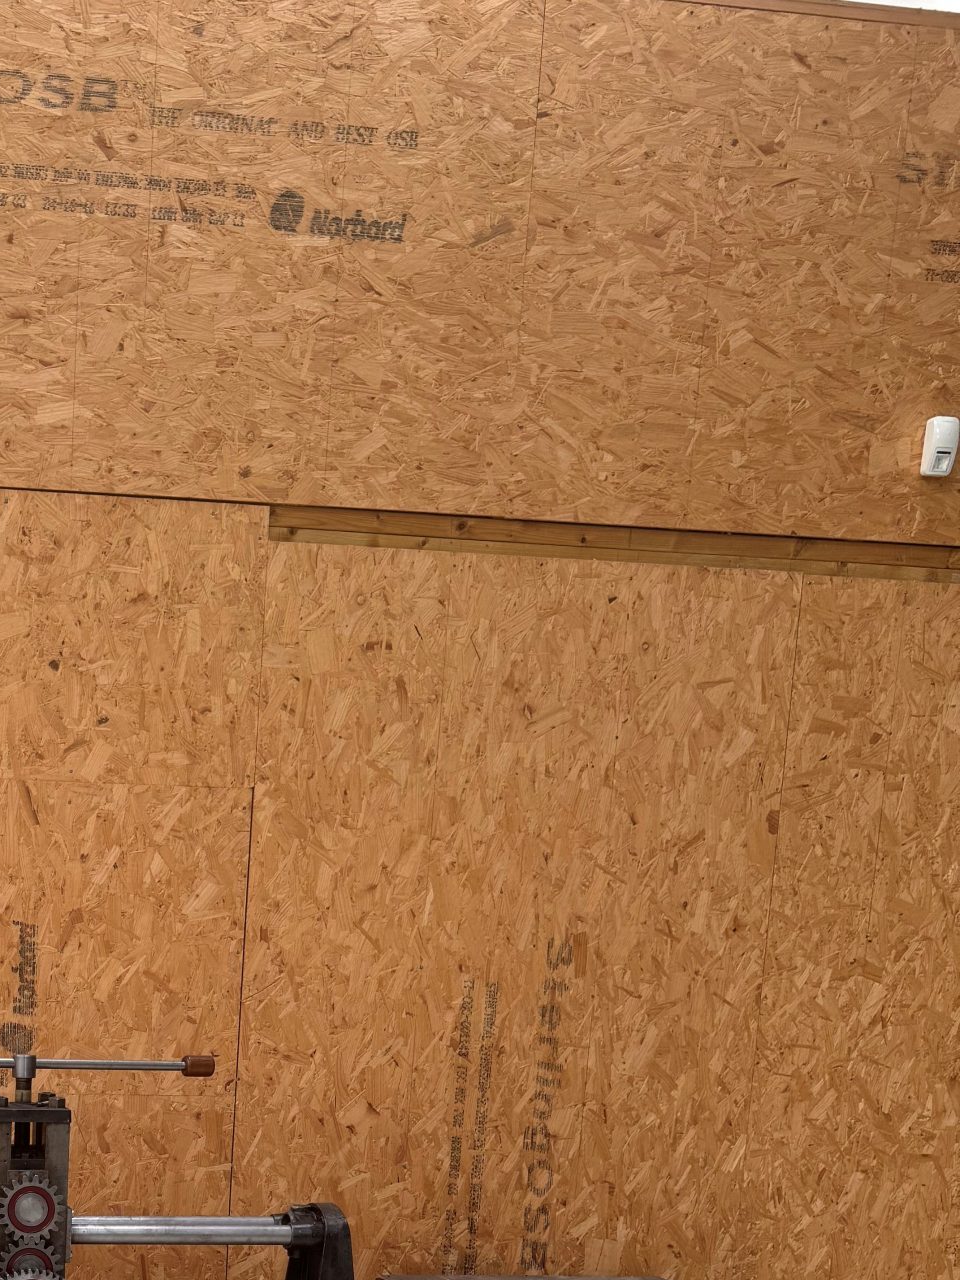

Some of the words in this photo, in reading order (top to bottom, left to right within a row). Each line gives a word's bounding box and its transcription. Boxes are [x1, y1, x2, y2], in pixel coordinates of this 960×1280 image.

[149, 105, 182, 128] THE
[192, 109, 280, 136] ORIGINAL
[288, 119, 327, 141] AND
[334, 122, 378, 146] BEST
[386, 128, 419, 149] OSB
[309, 206, 408, 244] Norbord
[12, 920, 37, 1016] Norbord
